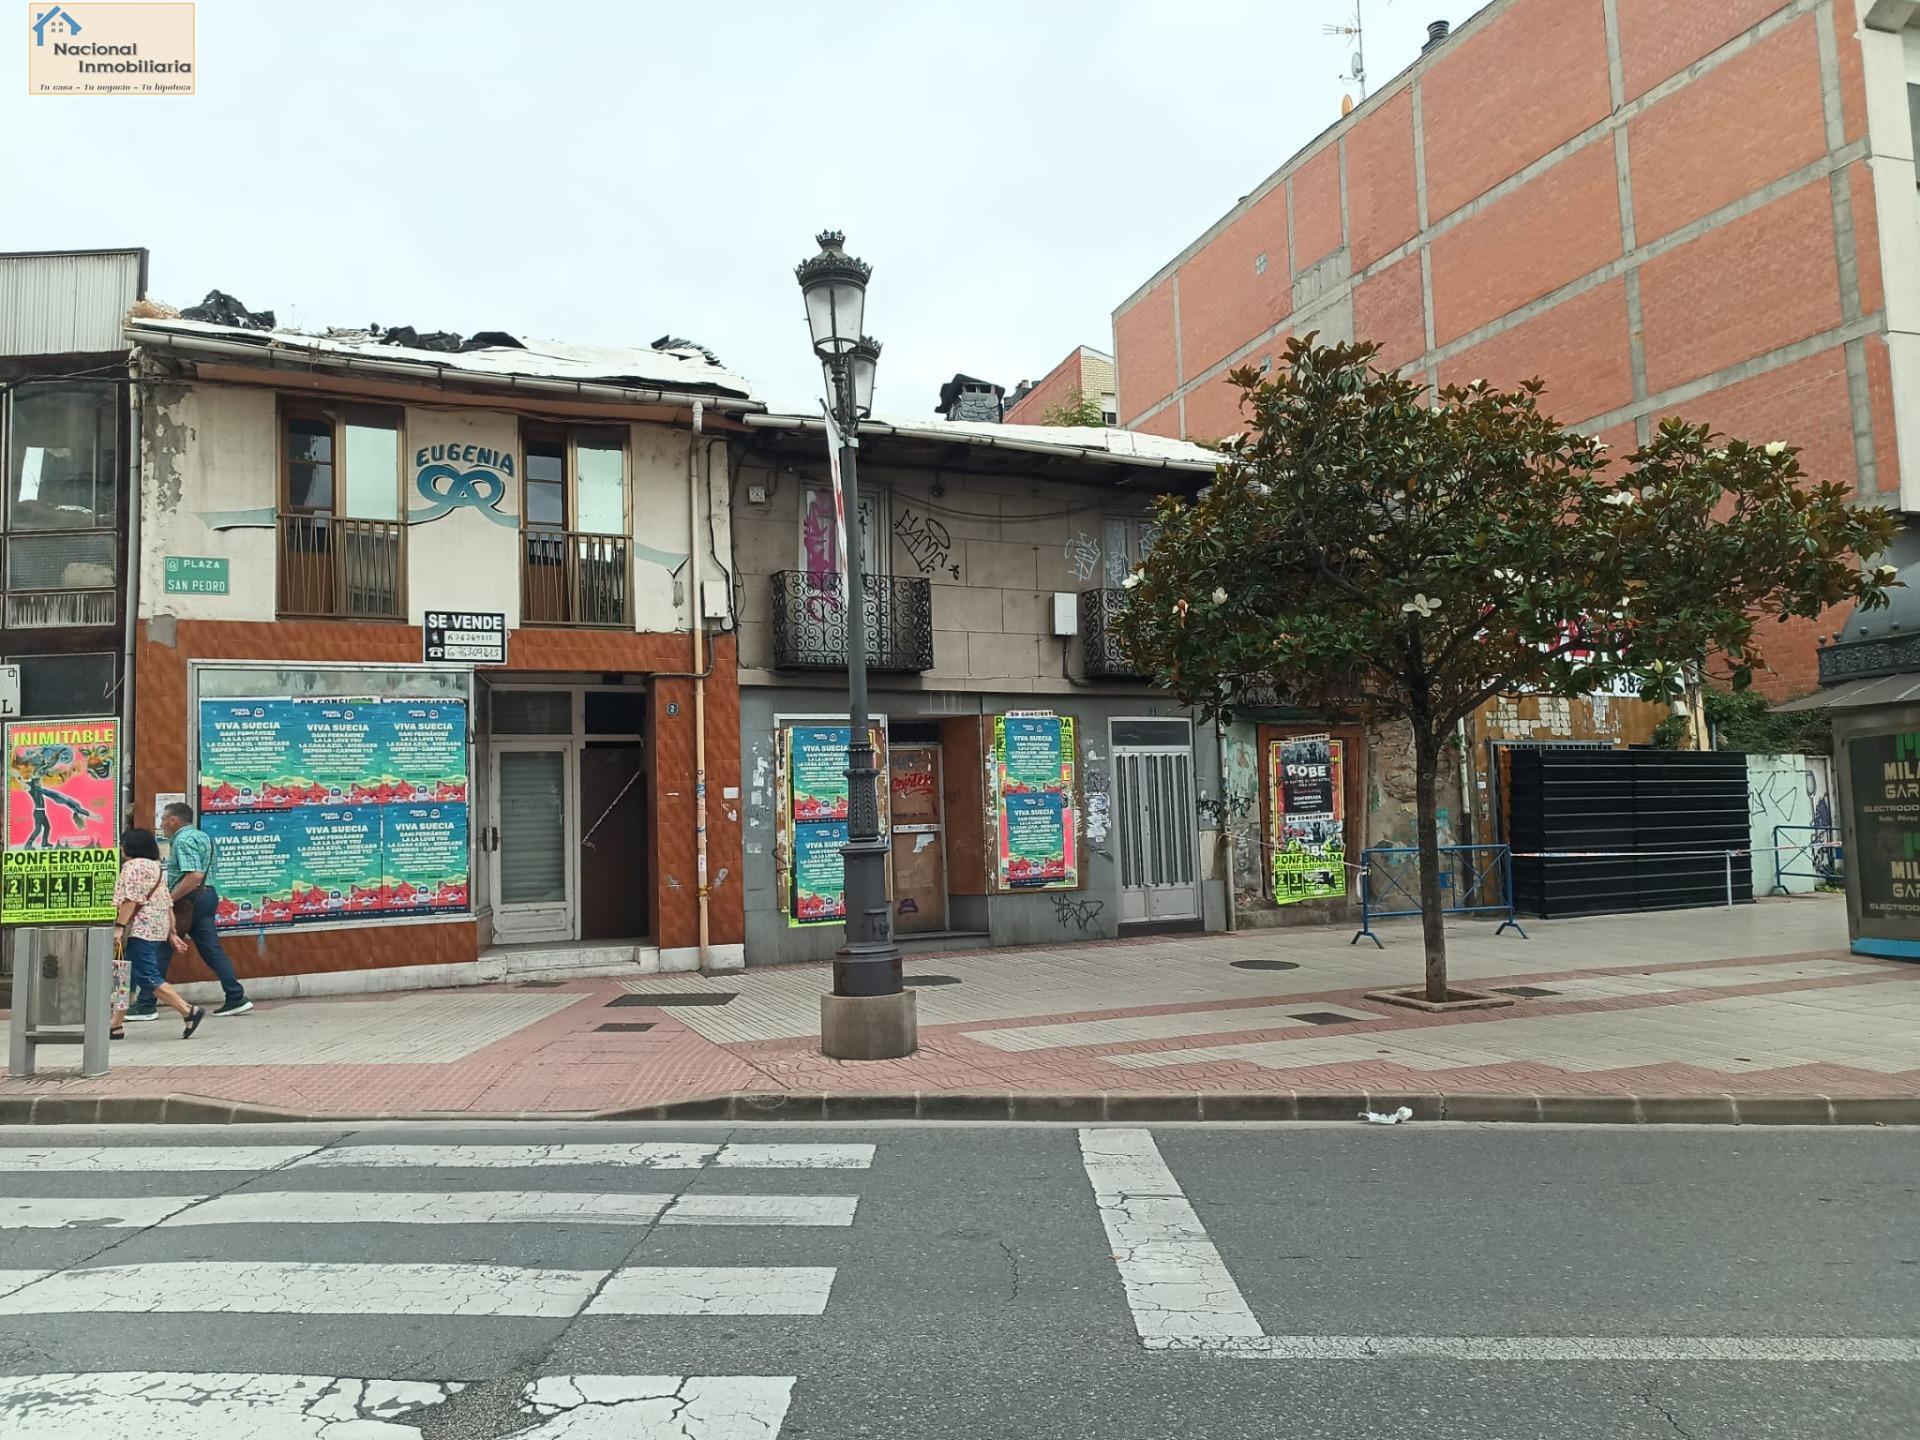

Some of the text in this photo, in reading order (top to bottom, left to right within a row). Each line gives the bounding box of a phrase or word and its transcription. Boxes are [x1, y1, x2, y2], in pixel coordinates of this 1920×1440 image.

[416, 444, 514, 478] EUGENIA
[184, 560, 220, 568] PLAZA
[168, 580, 225, 592] SAN PEDRO
[428, 614, 502, 630] SE VENDE
[14, 728, 114, 746] INIMITABLE
[1286, 764, 1326, 778] ROBE
[242, 834, 282, 842] SUECIA
[4, 850, 116, 865] PONFERRADA
[10, 880, 18, 893] 2
[32, 880, 40, 892] 3
[54, 878, 63, 892] 4
[78, 878, 86, 891] 5
